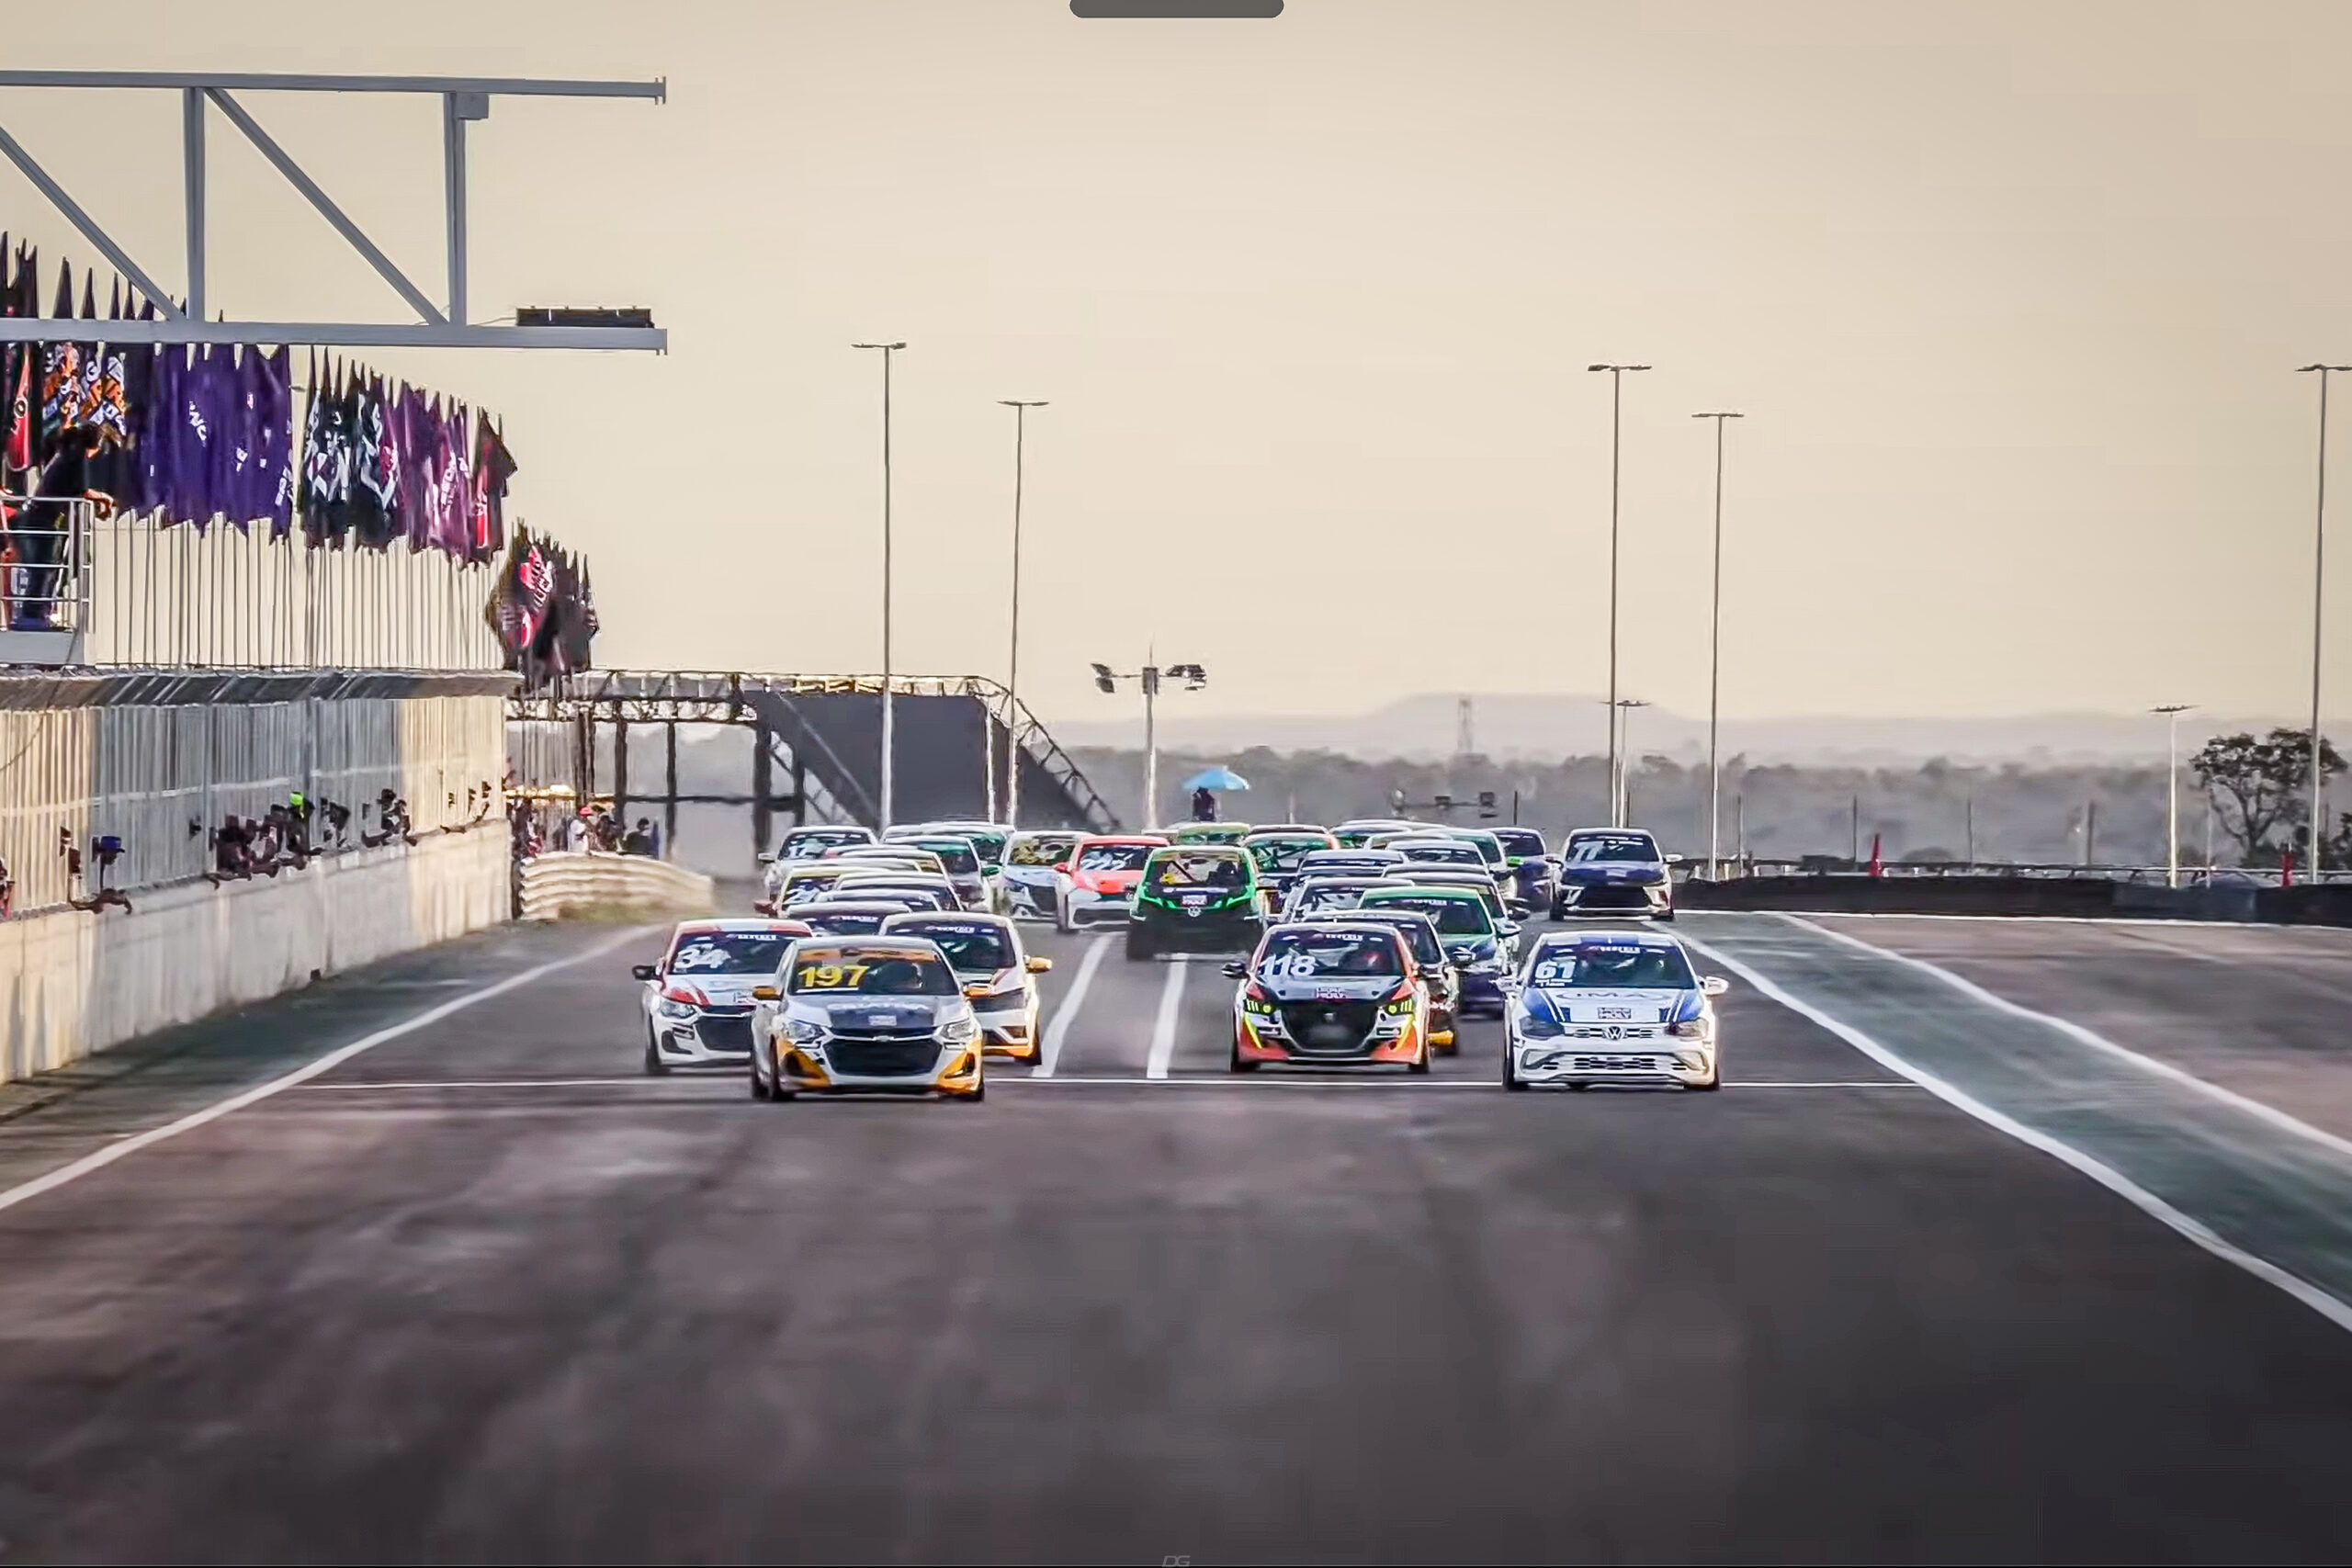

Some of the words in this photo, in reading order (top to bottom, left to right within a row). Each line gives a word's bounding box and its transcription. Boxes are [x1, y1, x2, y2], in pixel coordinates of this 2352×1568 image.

[798, 964, 870, 987] 197
[1259, 954, 1319, 976] 118
[1535, 961, 1577, 979] 61
